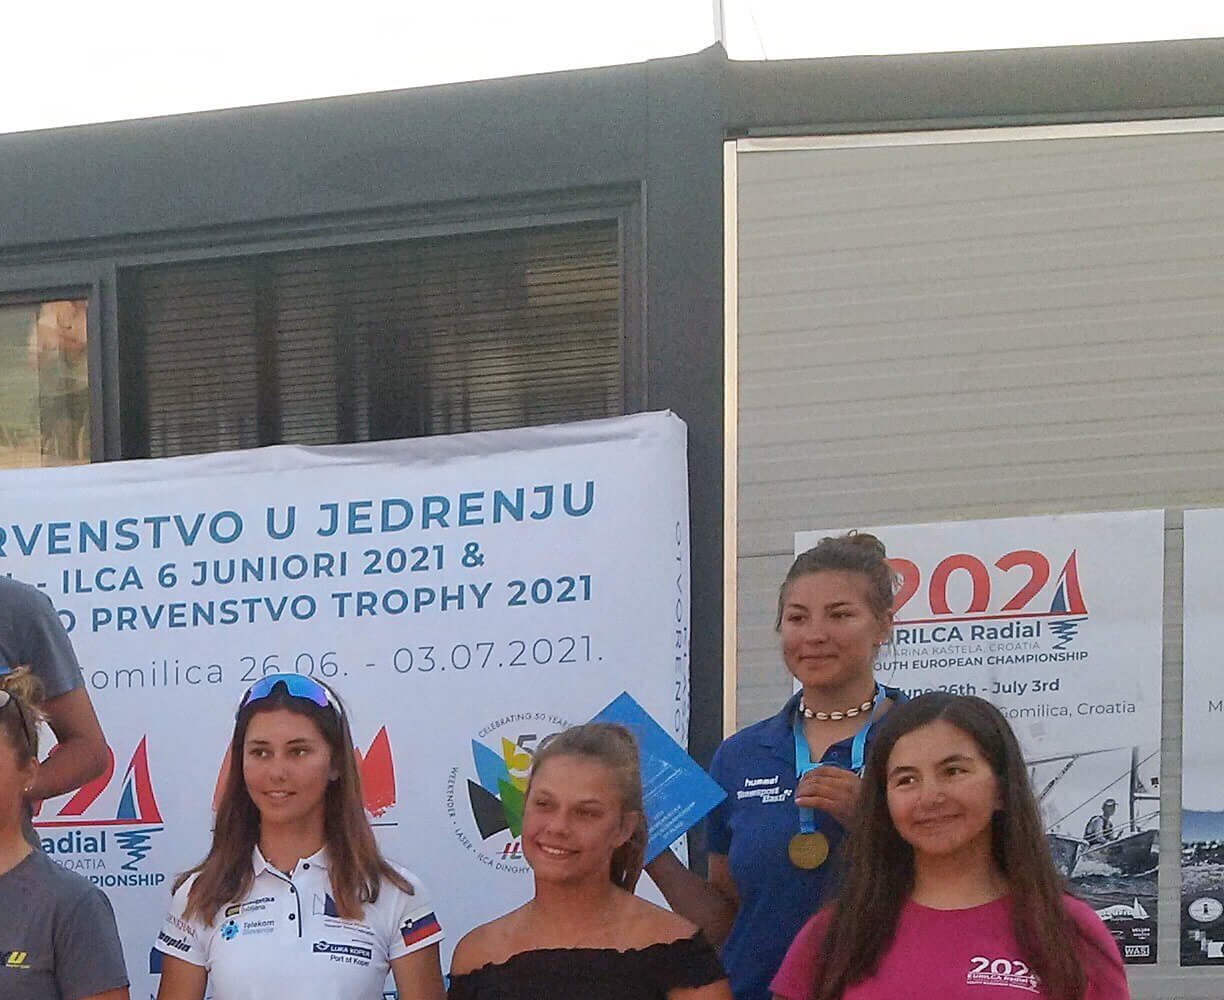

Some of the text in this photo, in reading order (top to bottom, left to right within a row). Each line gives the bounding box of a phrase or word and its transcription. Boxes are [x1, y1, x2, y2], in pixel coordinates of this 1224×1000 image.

[267, 506, 296, 540] U
[318, 480, 595, 537] JEDRENJU
[63, 566, 143, 593] ILCA
[157, 563, 176, 589] 6
[192, 550, 348, 587] JUNIORI
[363, 544, 444, 576] 2021
[461, 541, 485, 567] &
[92, 594, 317, 632] PRVENSTVO
[332, 582, 492, 619] TROPHY
[507, 575, 592, 606] 2021
[883, 621, 1041, 645] RILCA Radial
[989, 641, 1040, 652] CROATIA
[80, 659, 223, 690] omilica
[240, 652, 349, 682] 2606.
[392, 635, 604, 674] 03.07.2021.
[873, 651, 1089, 671] OUTH EUROPEAN CHAMPIONSHIP
[900, 687, 935, 697] une
[992, 680, 1027, 696] July
[1032, 678, 1059, 692] 3rd
[1077, 701, 1136, 715] Croatia
[41, 830, 106, 854] adial
[60, 859, 106, 871] OATIA
[89, 873, 165, 888] PIONSHIP
[243, 920, 275, 928] Telekom
[970, 956, 1030, 976] 202
